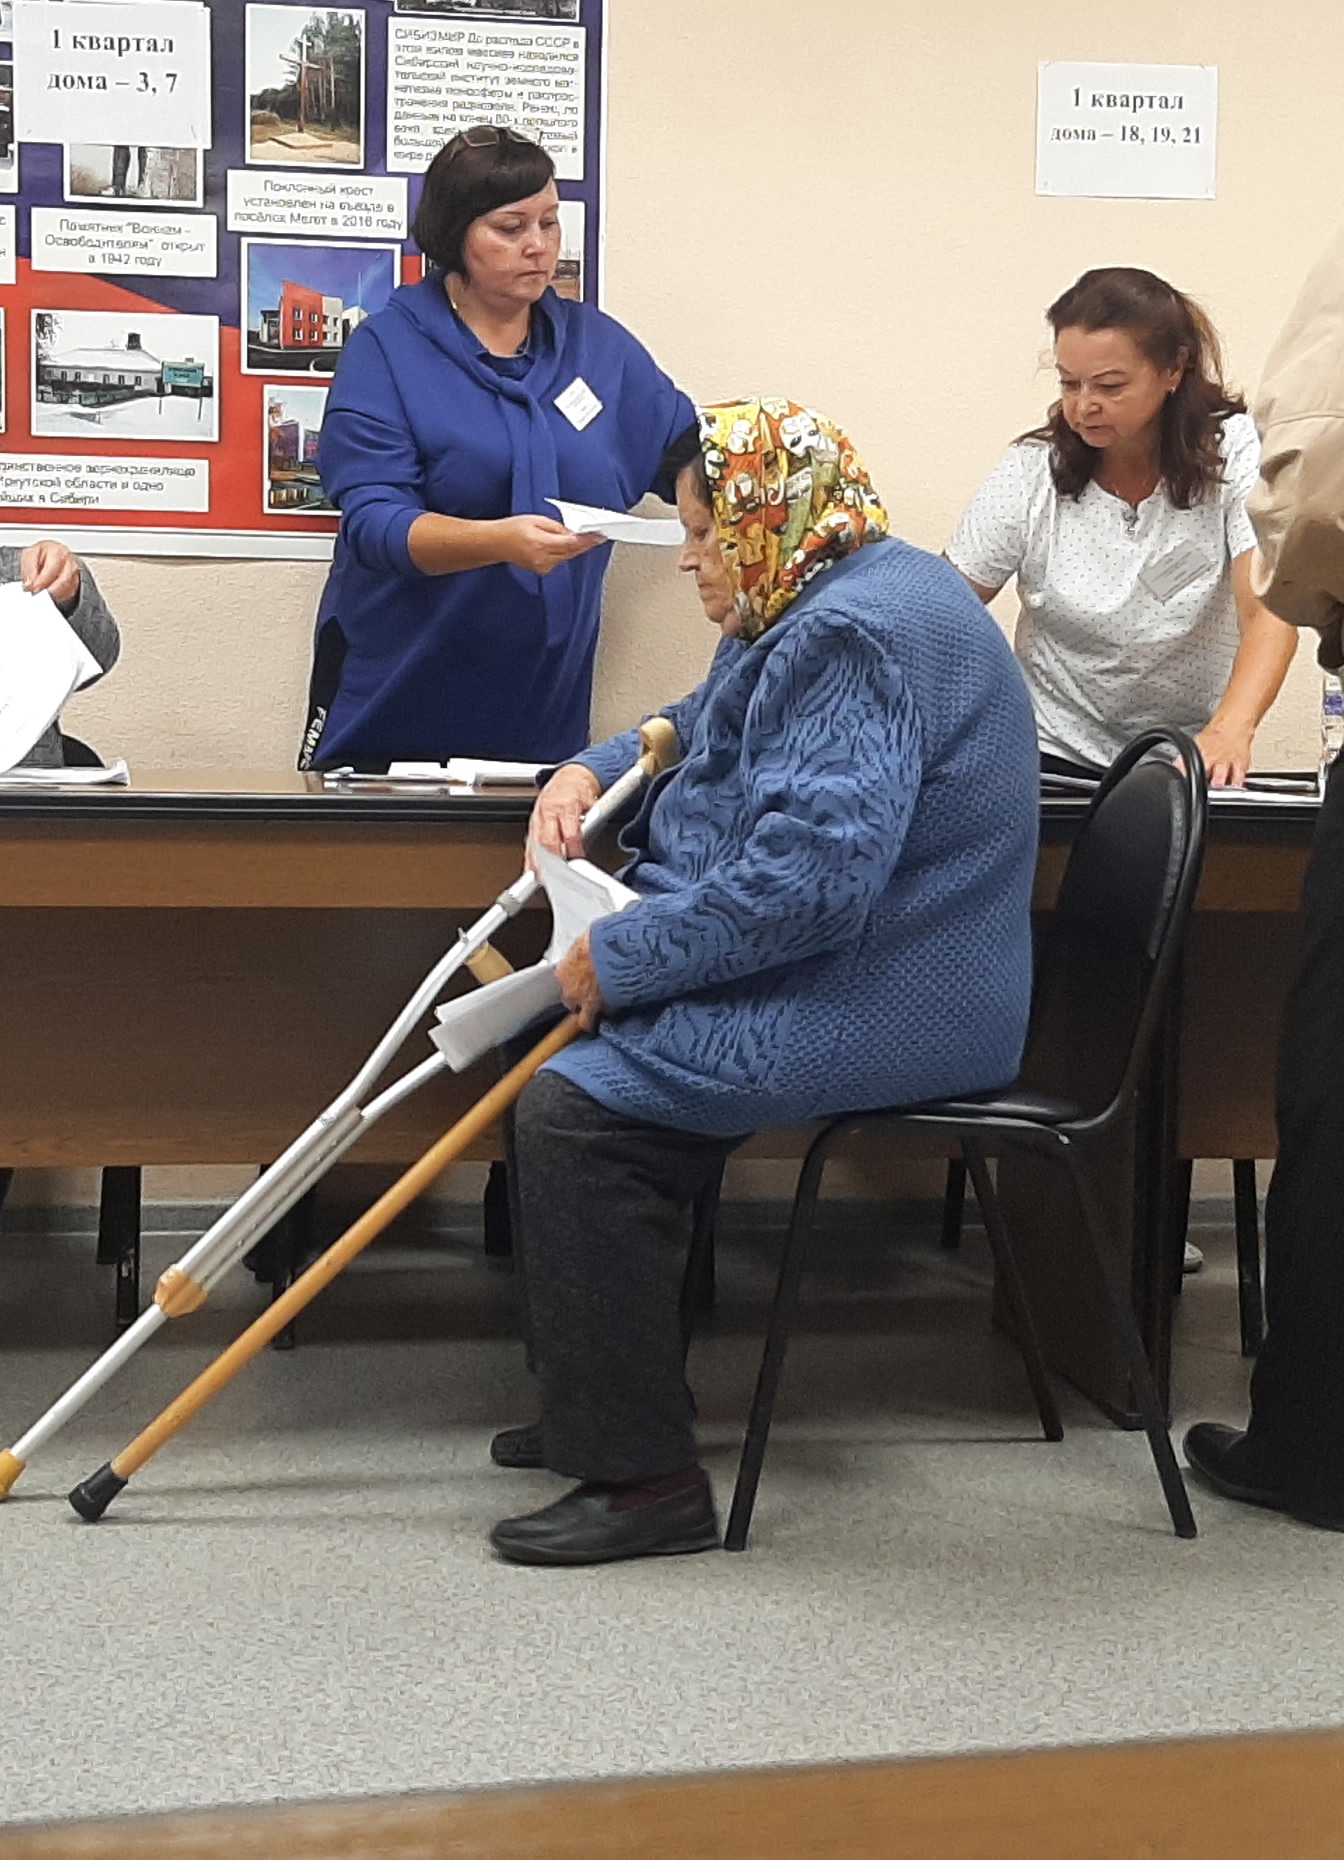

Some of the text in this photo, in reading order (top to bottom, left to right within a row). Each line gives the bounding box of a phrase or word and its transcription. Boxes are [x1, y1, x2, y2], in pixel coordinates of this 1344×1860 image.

[51, 29, 174, 57] 1 квартал
[47, 74, 107, 91] дома
[136, 72, 157, 94] 3,
[165, 73, 178, 93] 7
[1073, 87, 1183, 113] 1 квартал
[1050, 127, 1096, 141] дома
[1120, 125, 1145, 145] 18,
[1151, 126, 1176, 144] 19,
[1181, 126, 1201, 144] 21
